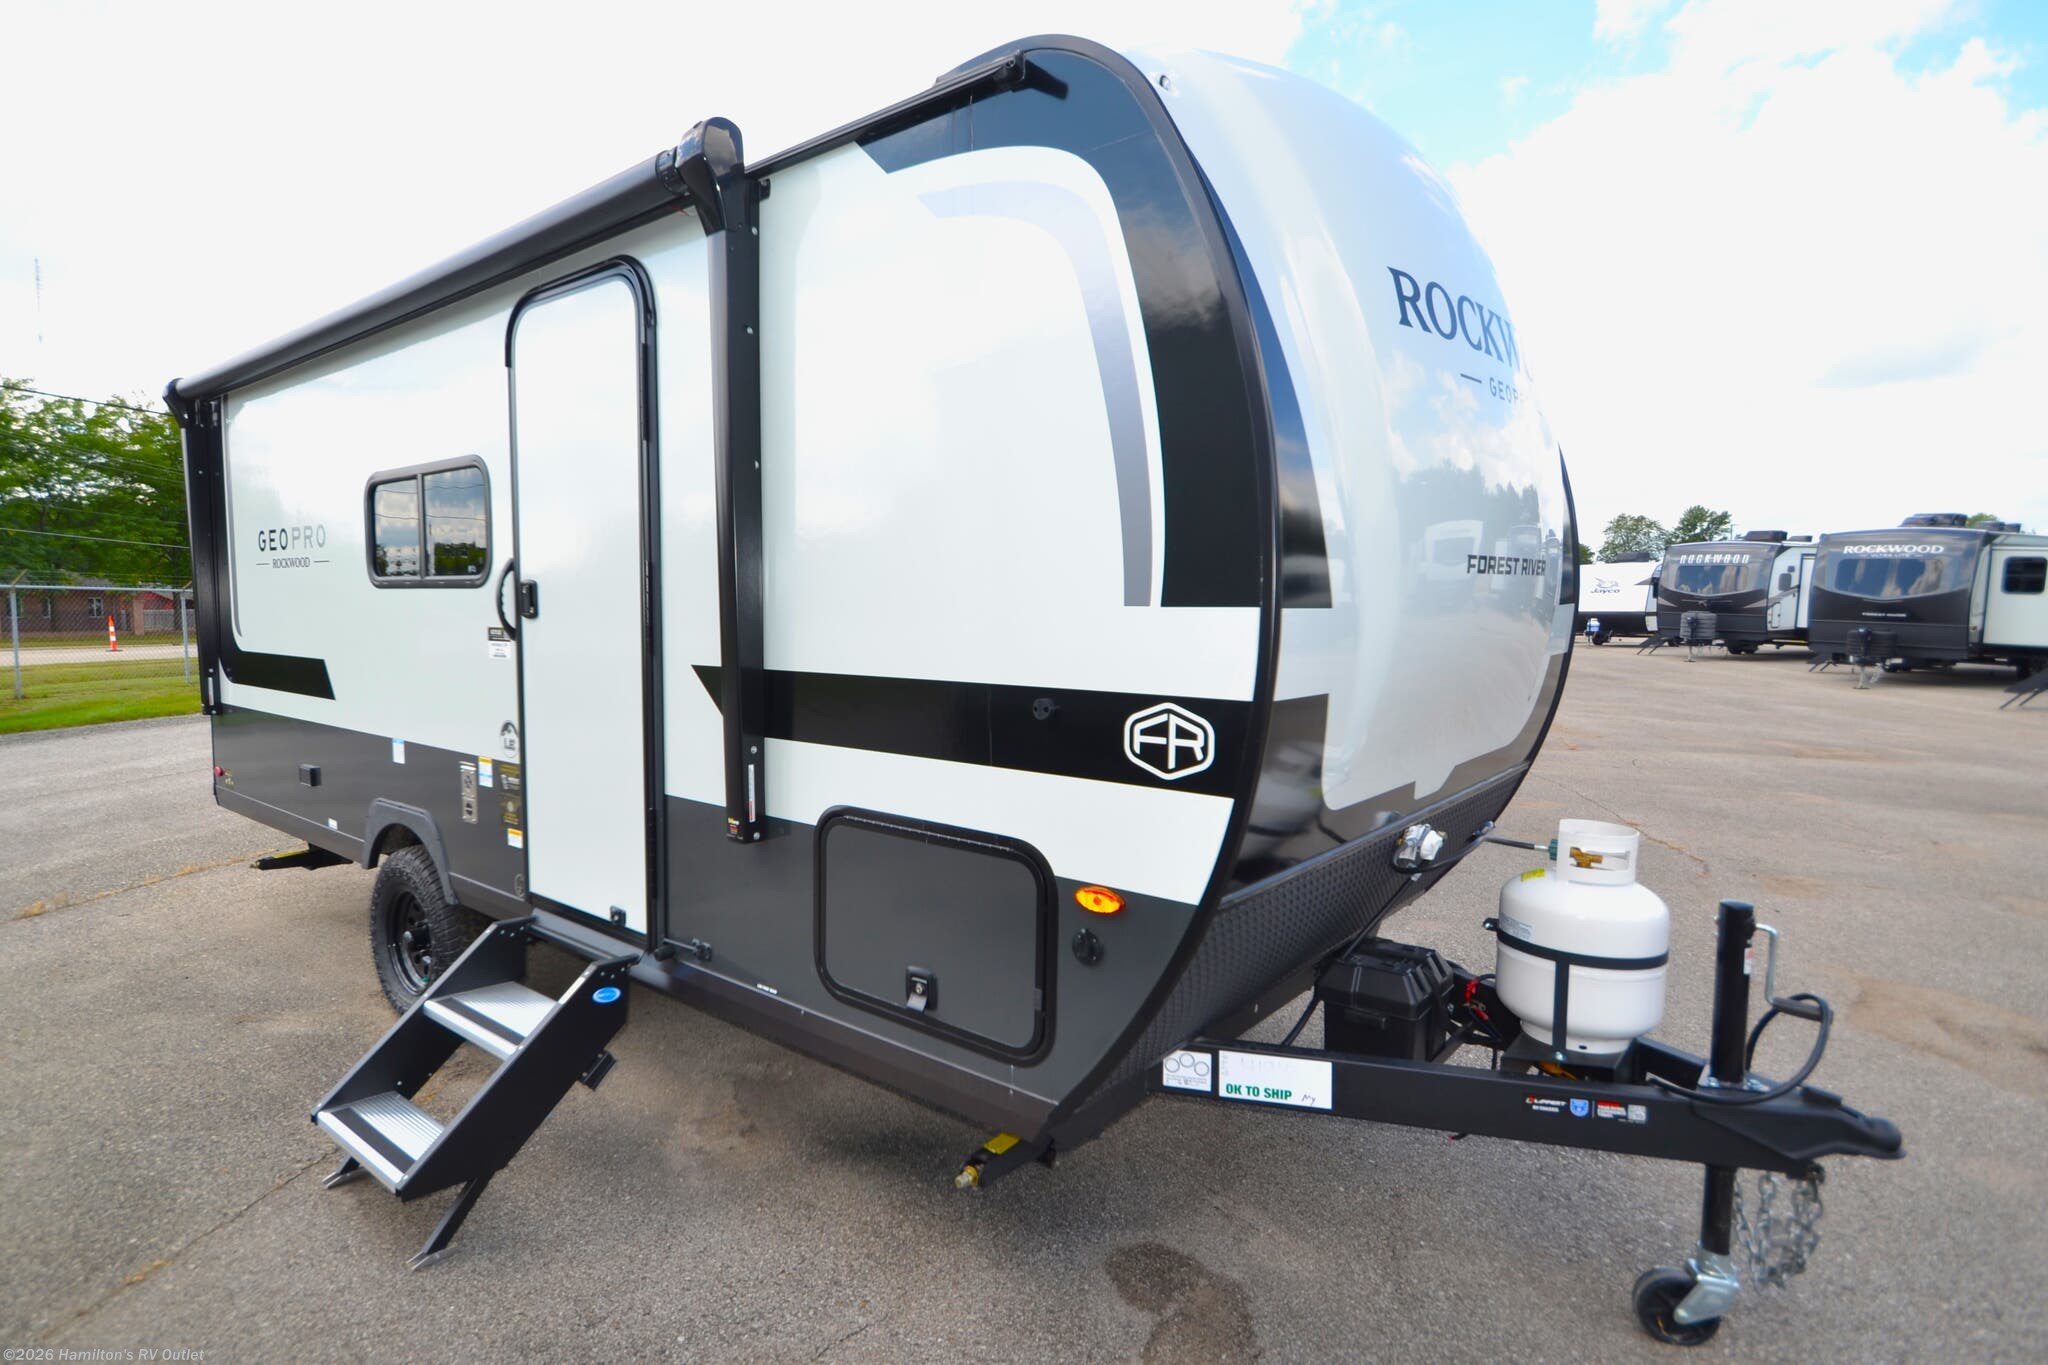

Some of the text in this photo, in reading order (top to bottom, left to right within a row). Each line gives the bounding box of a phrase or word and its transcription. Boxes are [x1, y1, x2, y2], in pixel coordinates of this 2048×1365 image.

[1387, 266, 1520, 371] ROCKW
[1489, 377, 1520, 406] GEOP
[258, 524, 326, 552] GEOPRO
[1843, 544, 1945, 554] ROCKWOOD
[272, 557, 311, 568] ROCKWOOD
[1467, 554, 1546, 576] FOREST RIVER
[1226, 1083, 1293, 1101] OK TO SHIP
